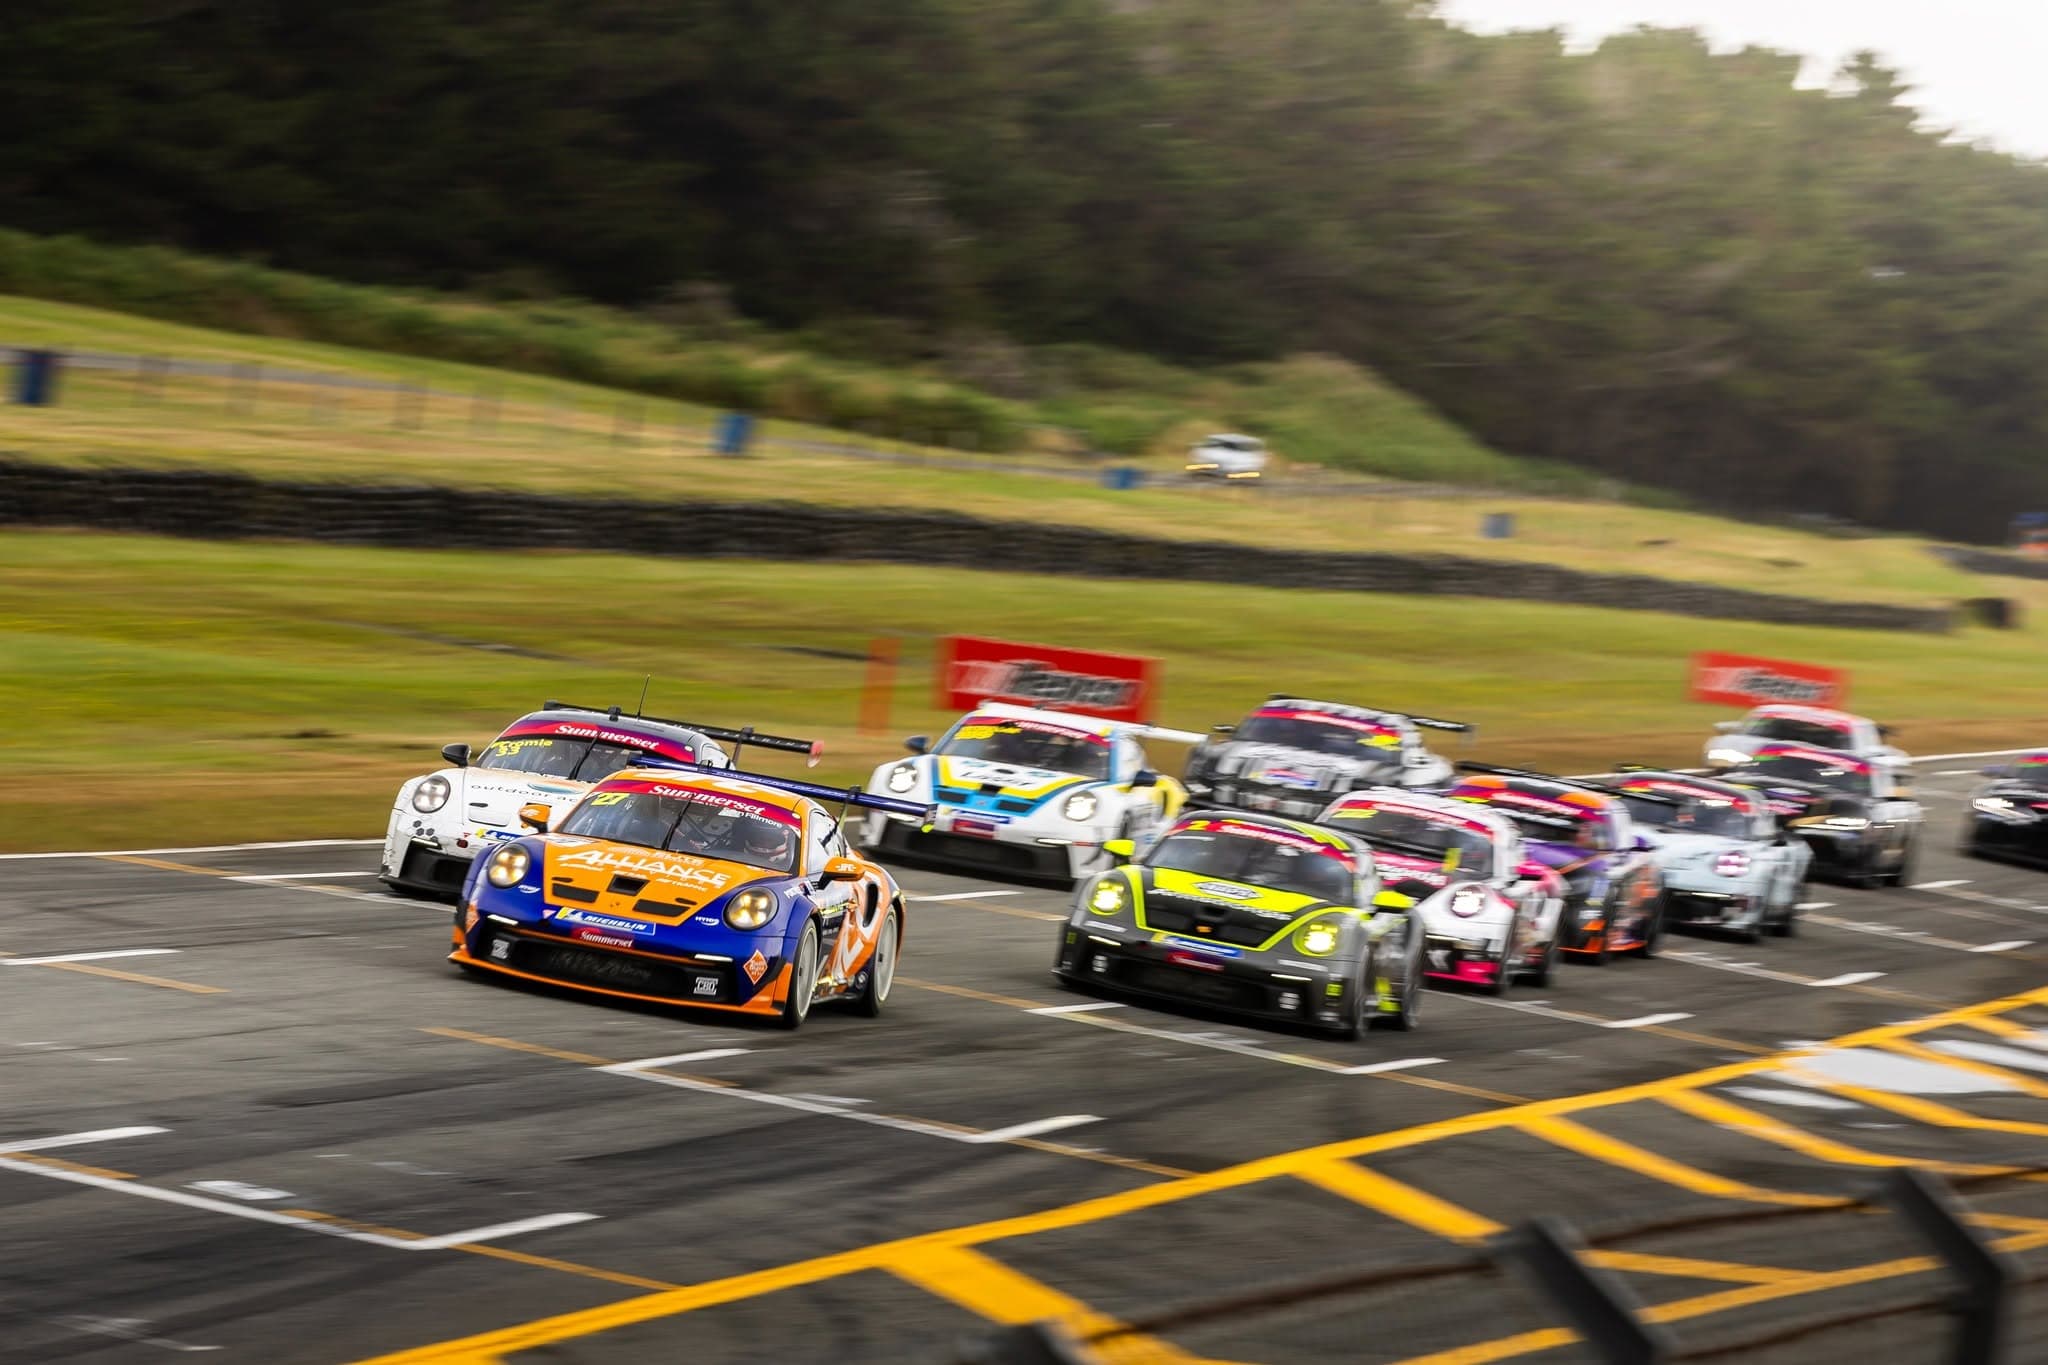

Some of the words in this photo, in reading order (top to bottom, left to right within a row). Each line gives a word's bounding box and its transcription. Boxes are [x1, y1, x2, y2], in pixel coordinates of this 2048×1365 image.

[556, 724, 660, 750] Summerset
[471, 784, 549, 798] outdoor
[591, 793, 630, 806] 27
[649, 785, 766, 814] Summerset
[744, 811, 783, 829] Fillmore
[557, 849, 732, 888] ALLIANCE
[583, 914, 647, 931] MICHELIN
[580, 930, 633, 948] Summerset
